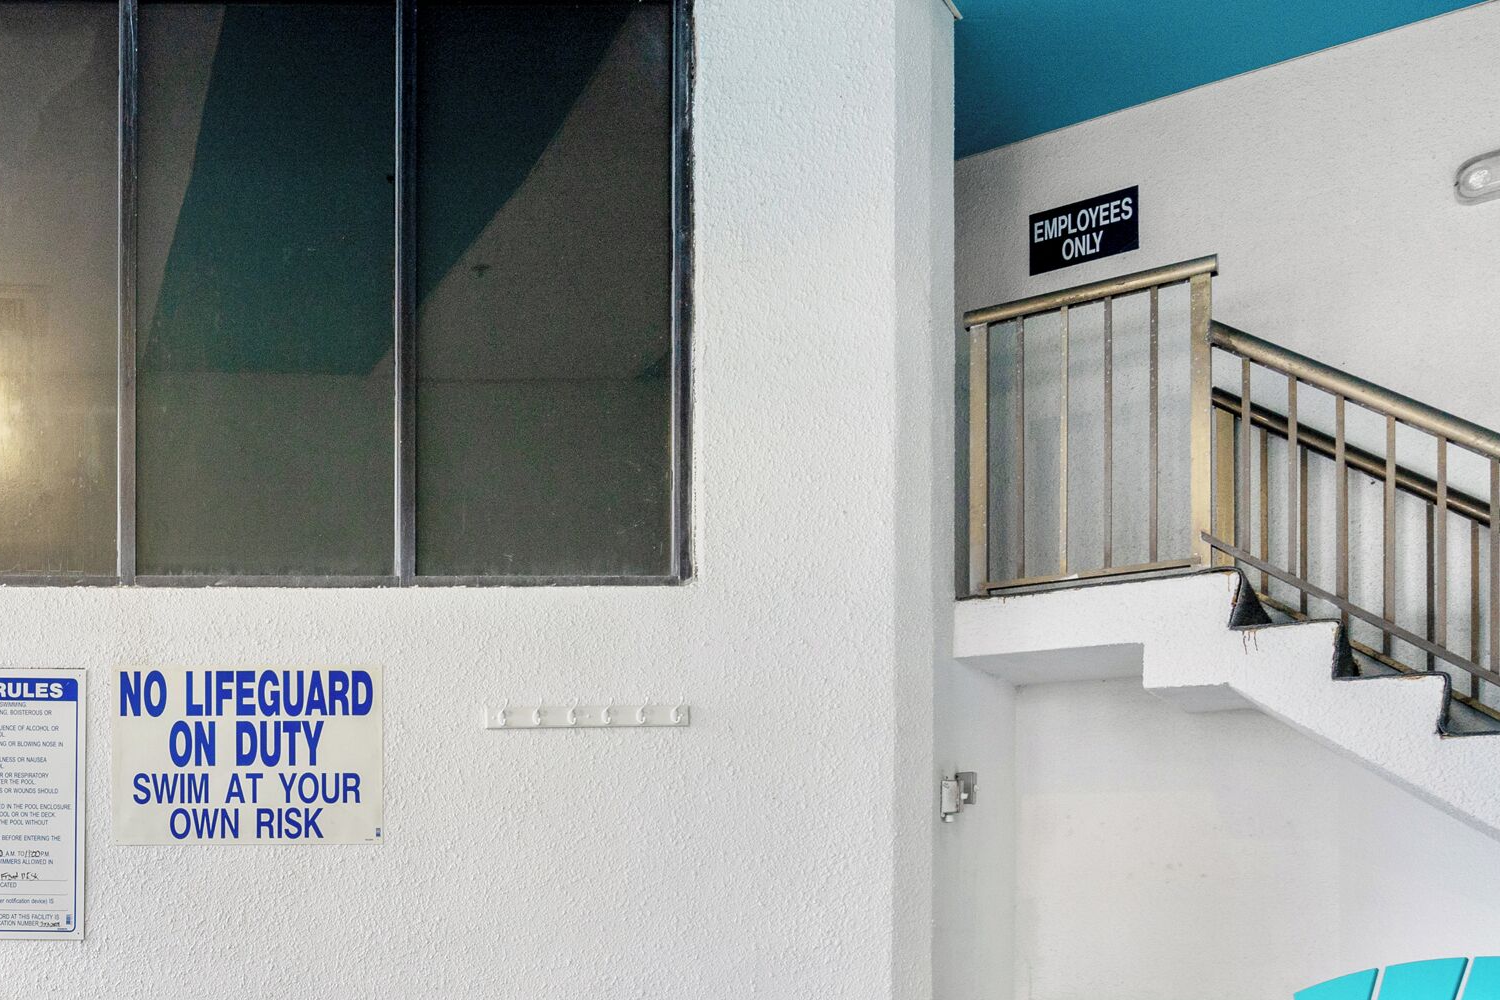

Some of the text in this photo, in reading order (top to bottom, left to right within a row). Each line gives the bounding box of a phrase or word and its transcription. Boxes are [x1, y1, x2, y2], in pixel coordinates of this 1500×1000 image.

[1034, 197, 1133, 243] EMPLOYEES
[1062, 230, 1104, 260] ONLY
[120, 670, 374, 717] NO LIFEGUARD
[169, 720, 324, 767] ON DUTY
[132, 772, 361, 804] SWIM AT YOUR
[170, 808, 324, 839] OWN RISK
